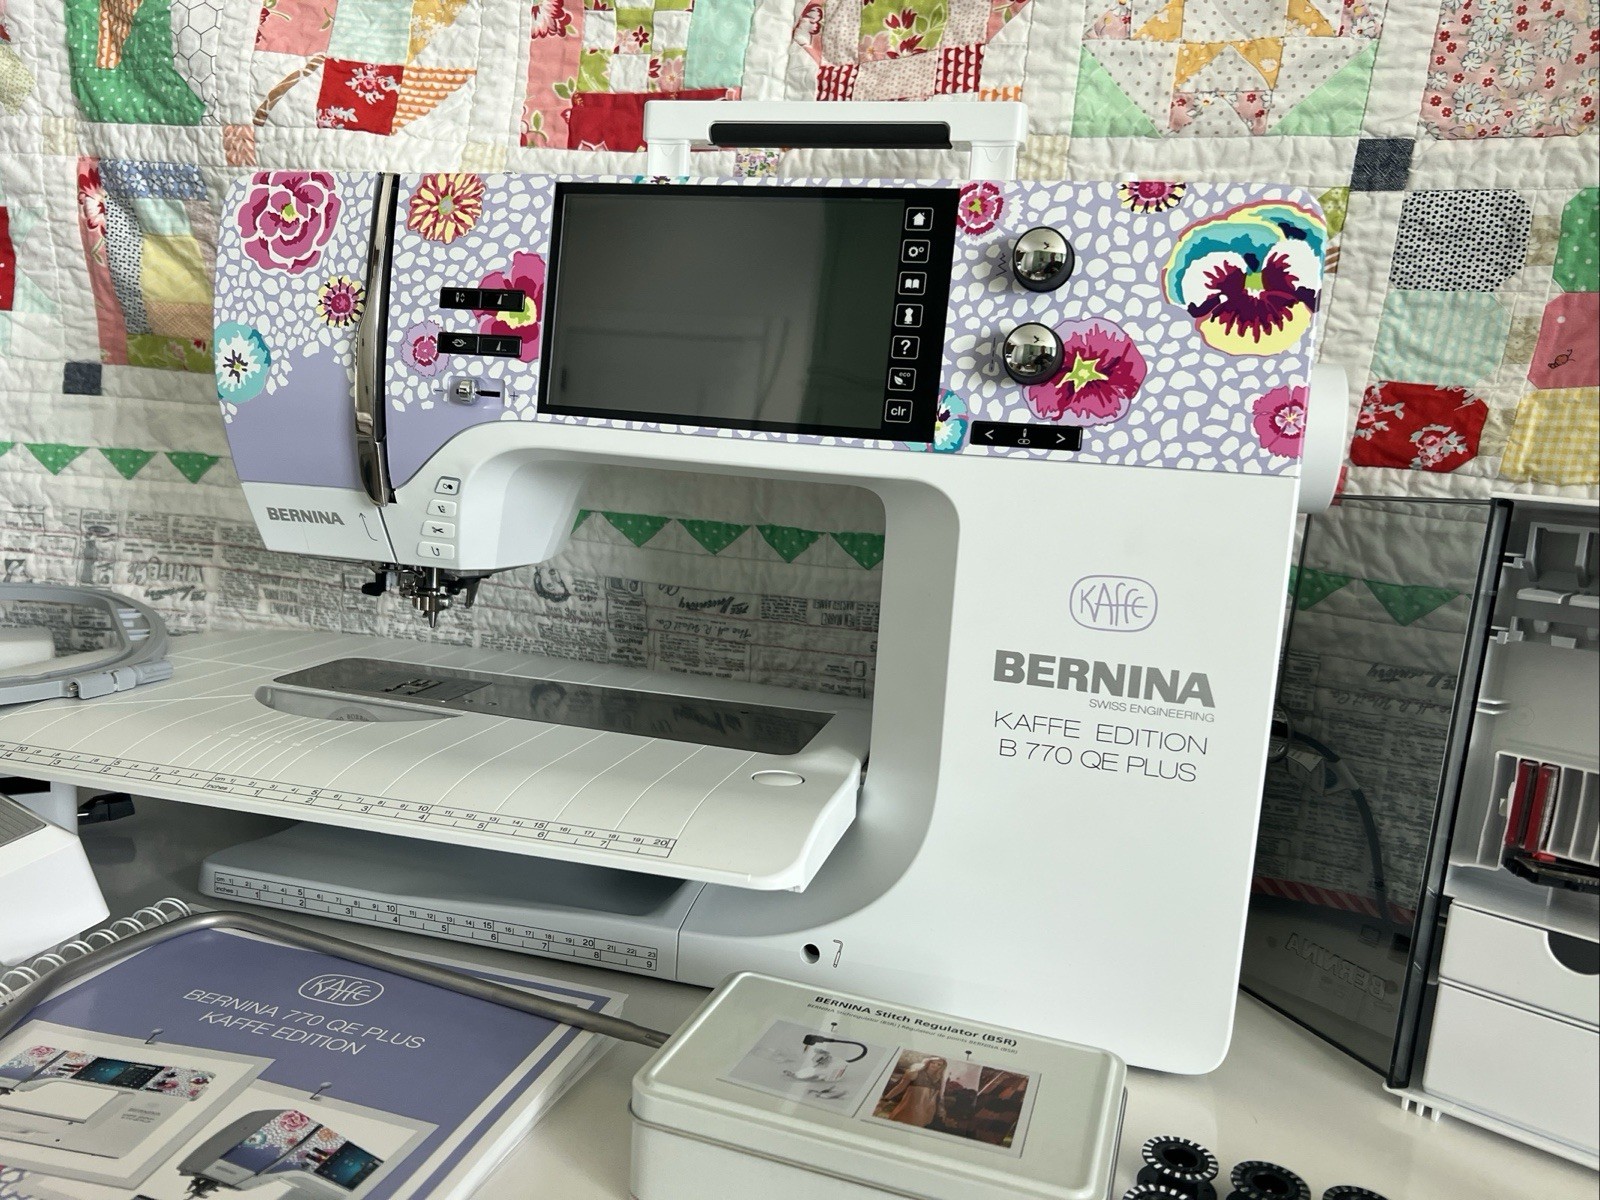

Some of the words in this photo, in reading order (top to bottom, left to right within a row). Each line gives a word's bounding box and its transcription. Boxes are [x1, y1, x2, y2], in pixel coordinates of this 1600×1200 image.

[890, 405, 907, 417] clr
[266, 507, 345, 526] BERNINA
[993, 649, 1216, 708] BERNINA
[1089, 698, 1127, 712] SWISS
[1129, 703, 1215, 723] ENGINEERING
[994, 711, 1081, 739] KAFFE
[1096, 723, 1208, 755] EDITION
[999, 738, 1017, 757] B
[1026, 742, 1073, 765] 770
[1080, 750, 1119, 772] QE
[1126, 756, 1197, 782] PLUS
[533, 821, 545, 829] 15
[215, 886, 234, 894] inches
[299, 899, 304, 907] 2
[345, 907, 351, 915] 3
[441, 924, 447, 932] 5
[491, 933, 497, 941] 6
[593, 951, 600, 959] 8
[646, 960, 653, 968] 9
[297, 888, 303, 896] 5
[386, 905, 396, 913] 10
[483, 921, 492, 930] 15
[582, 938, 594, 947] 20
[183, 989, 279, 1018] BERNINA
[282, 1009, 325, 1026] 770
[326, 1019, 364, 1035] QE
[361, 1027, 426, 1049] PLUS
[807, 1003, 835, 1013] BERNINA
[815, 996, 871, 1014] BERNINA
[875, 1009, 911, 1023] Stitch
[914, 1018, 979, 1038] Regulator
[982, 1032, 1018, 1047] (BSR)
[199, 1011, 275, 1035] KAFFE
[271, 1026, 366, 1055] EDITION
